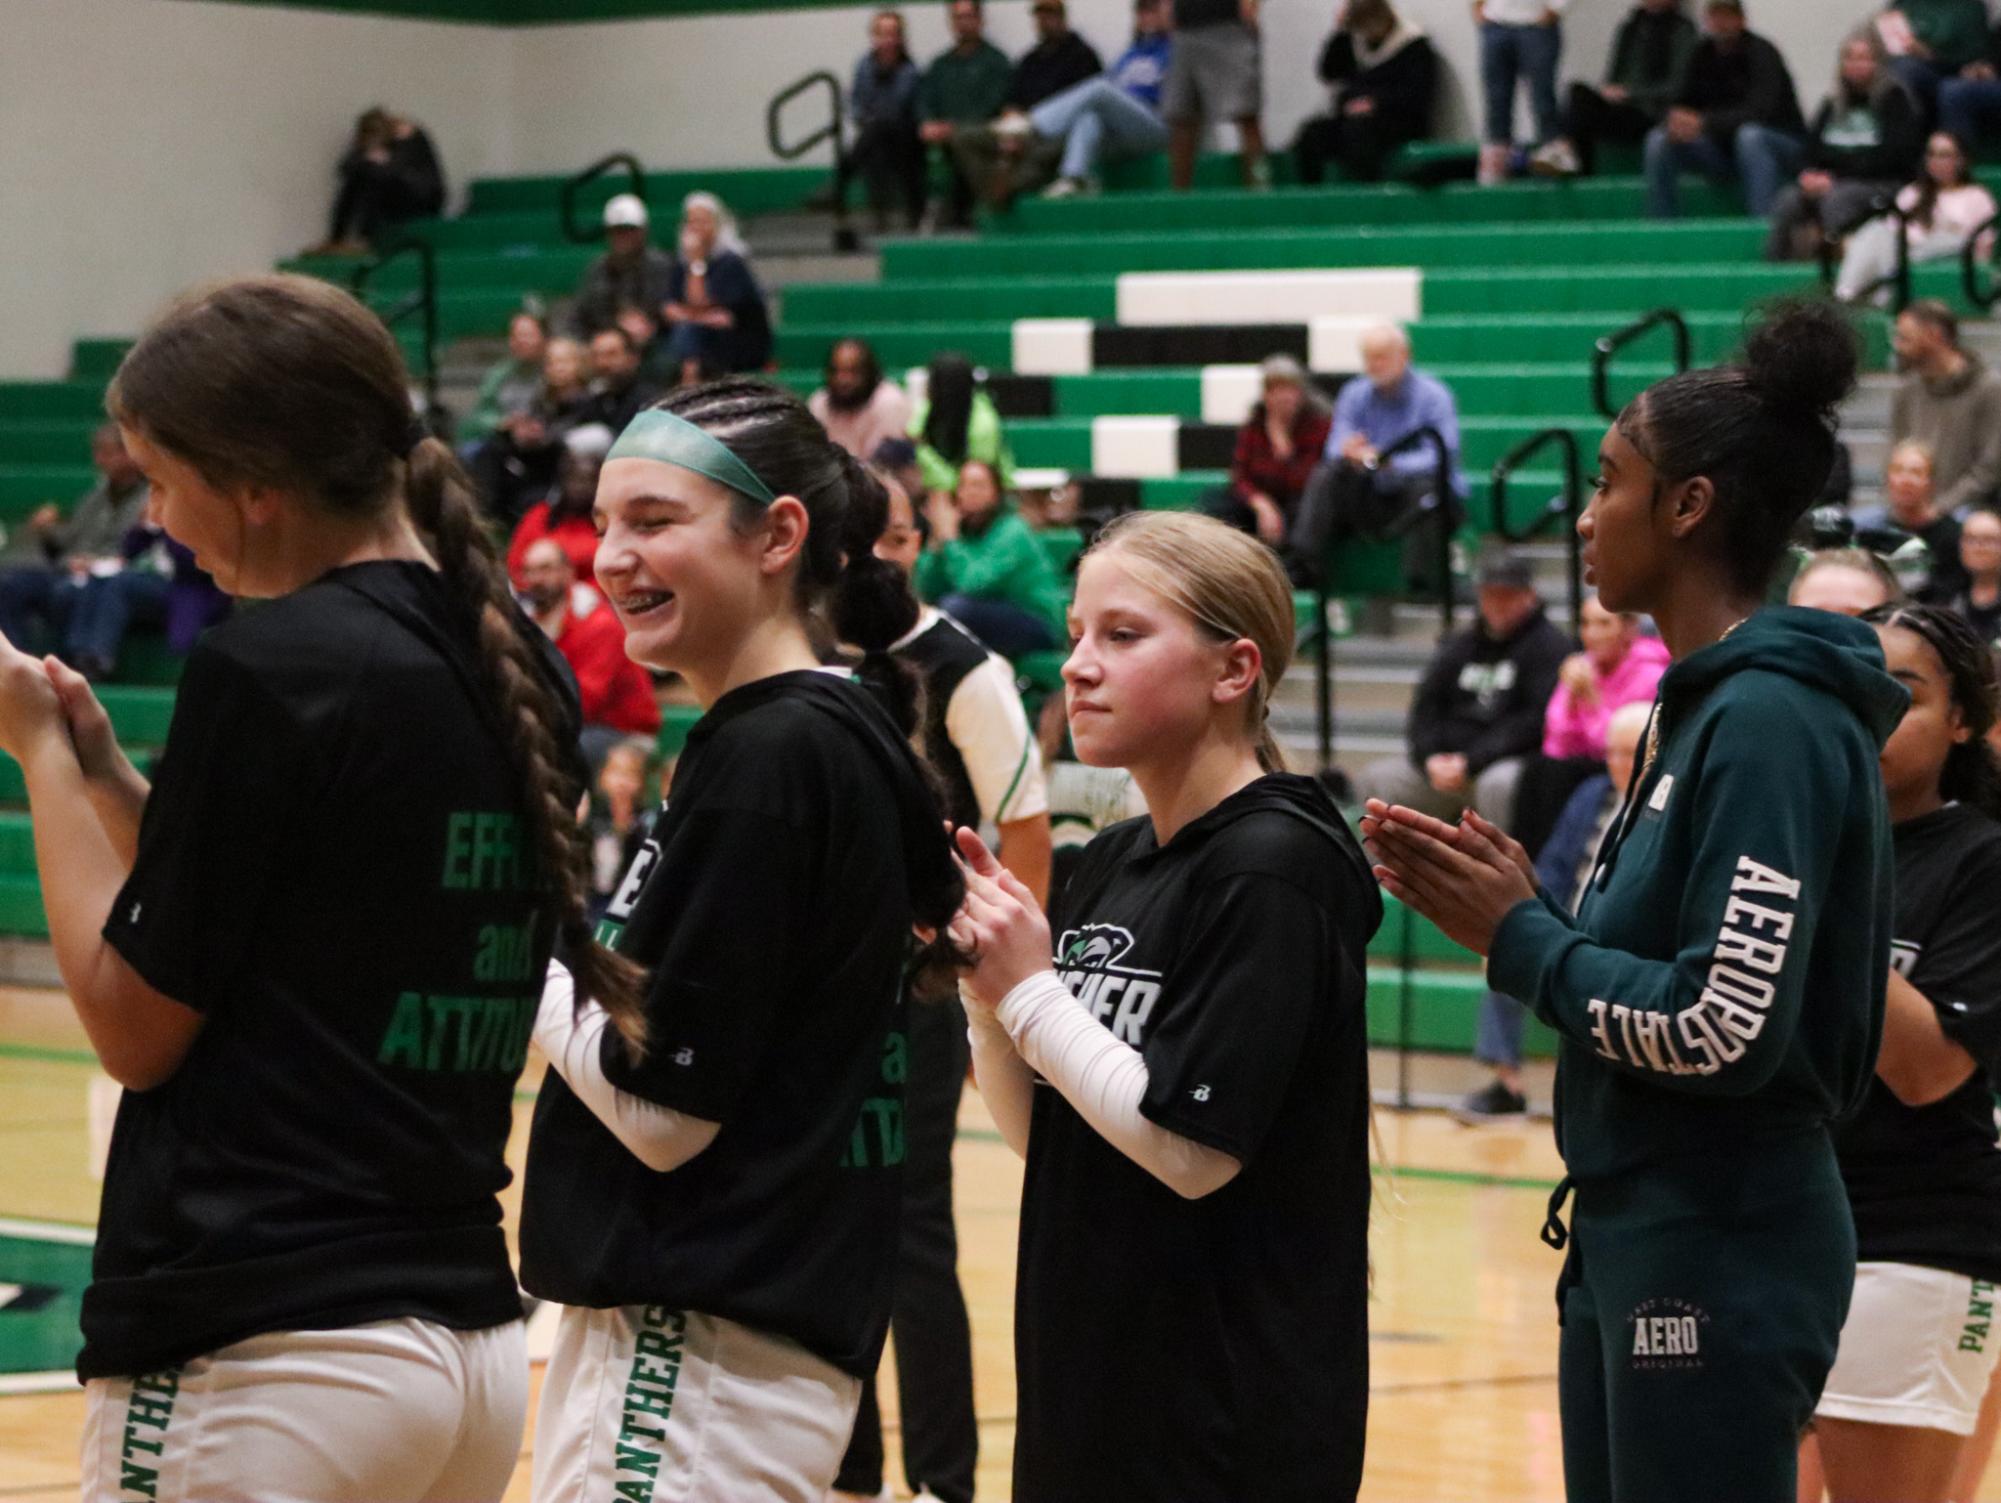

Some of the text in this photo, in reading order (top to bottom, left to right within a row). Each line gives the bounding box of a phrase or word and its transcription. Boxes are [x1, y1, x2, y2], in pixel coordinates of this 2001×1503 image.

[612, 1300, 687, 1503] ANTHERS
[1632, 1315, 1699, 1355] AERO
[120, 1370, 180, 1503] NTHE
